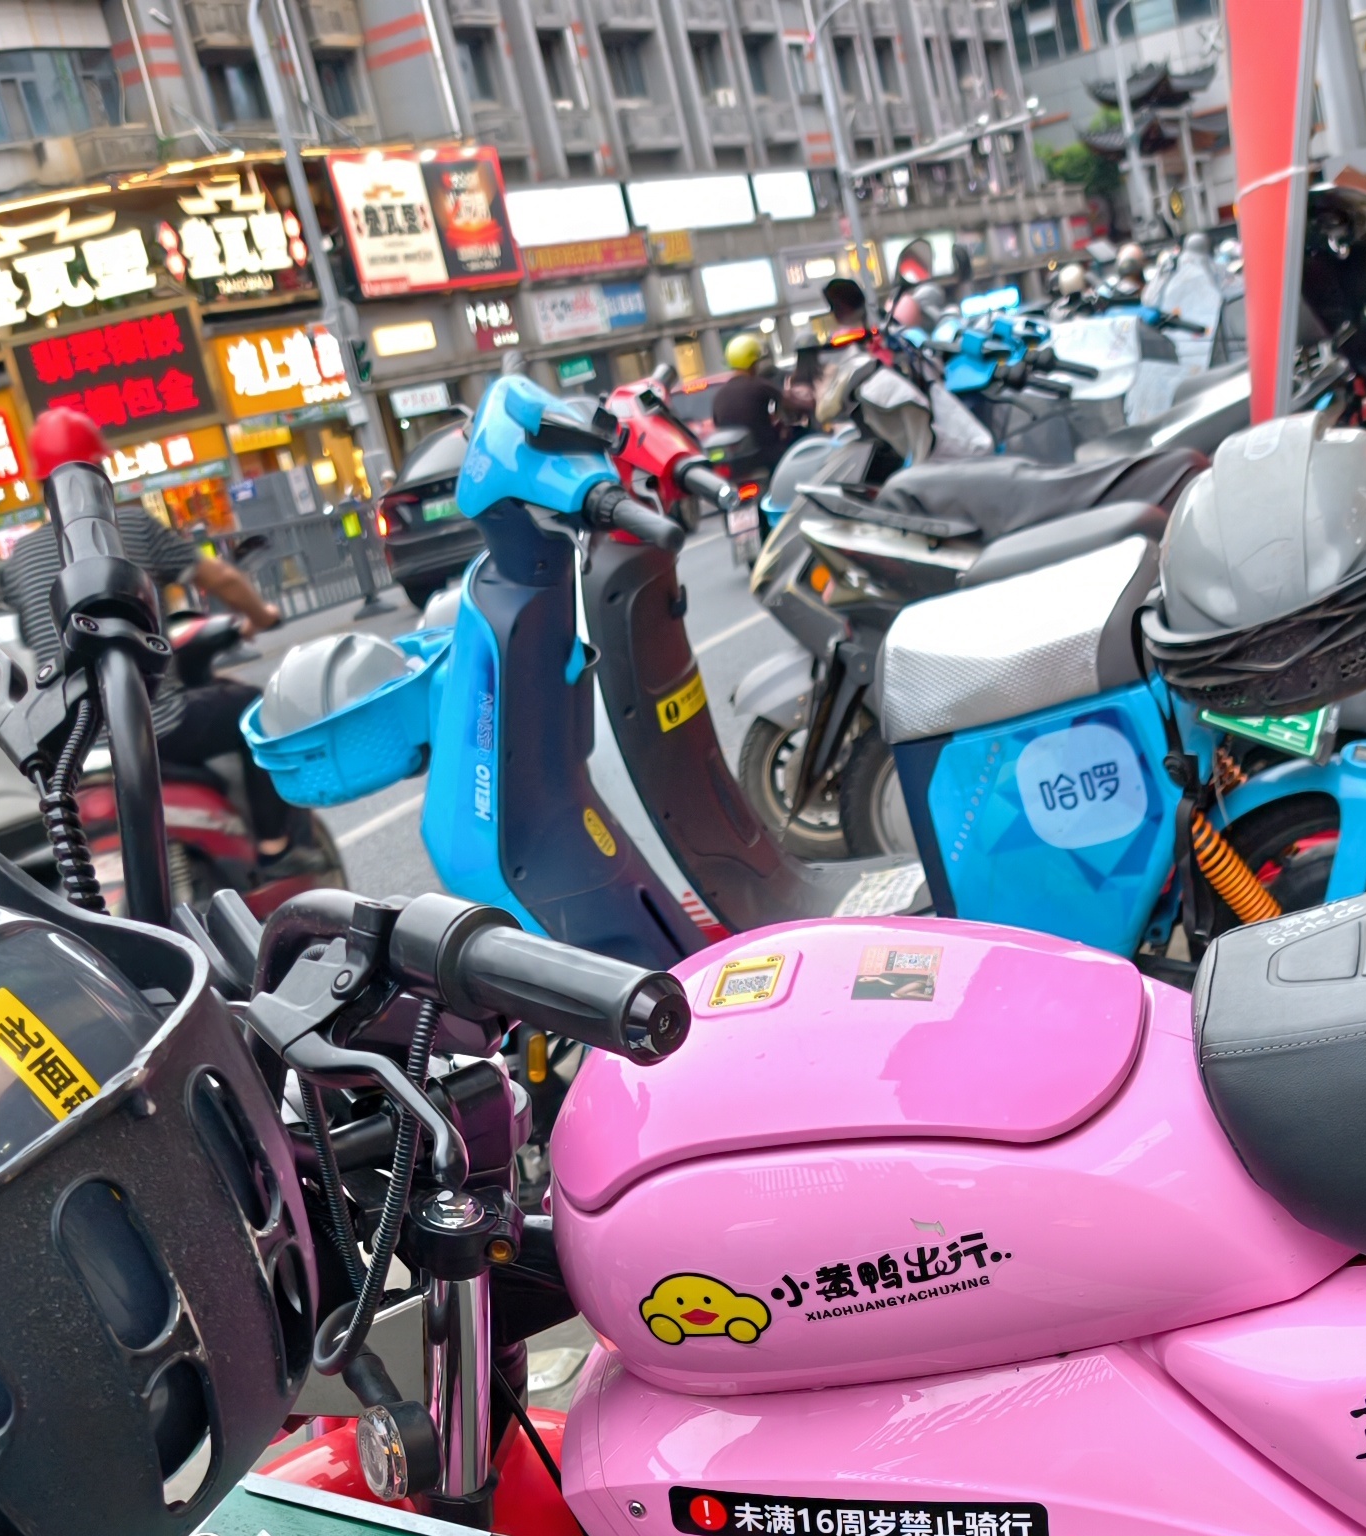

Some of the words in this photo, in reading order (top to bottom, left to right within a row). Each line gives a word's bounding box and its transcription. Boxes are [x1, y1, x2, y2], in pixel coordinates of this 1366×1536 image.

[475, 764, 491, 821] HELLO
[1039, 761, 1120, 812] 哈啰
[805, 1275, 991, 1322] XIAOHUANGYACHUXING
